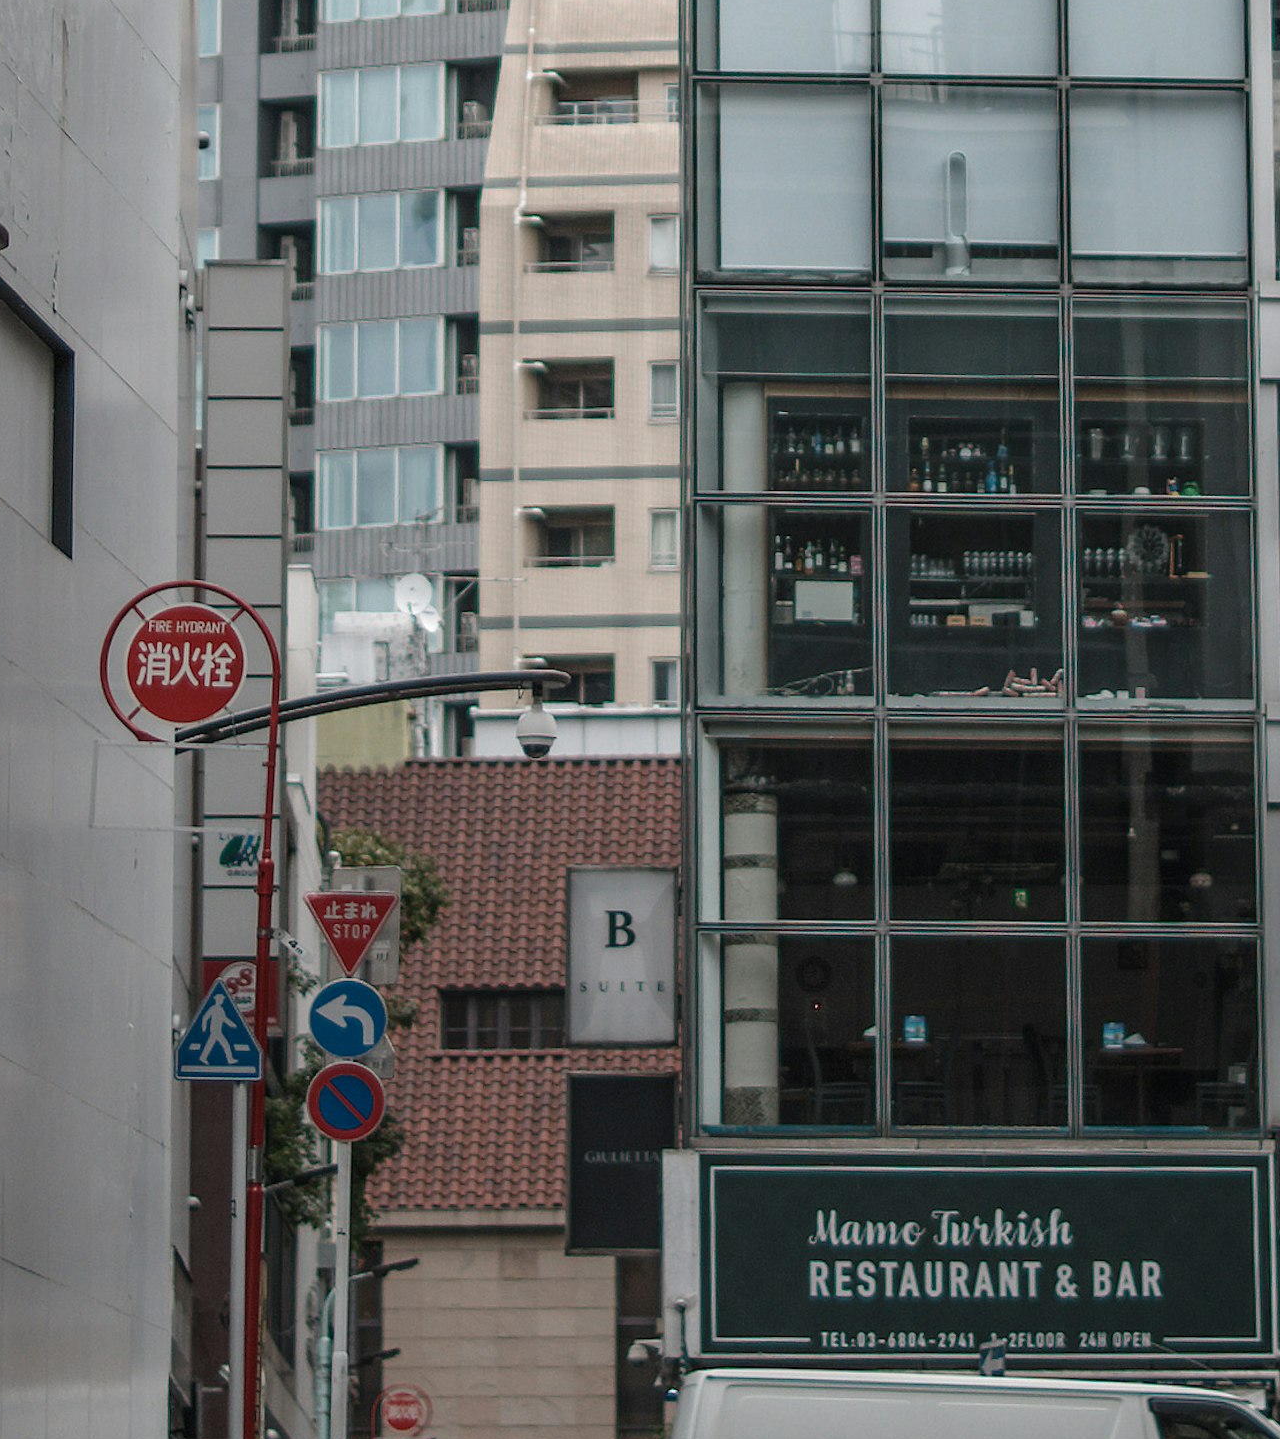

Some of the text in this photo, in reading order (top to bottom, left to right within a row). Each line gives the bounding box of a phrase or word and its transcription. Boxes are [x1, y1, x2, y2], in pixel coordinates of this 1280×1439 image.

[148, 619, 228, 634] FIRE HYDRANT
[136, 640, 237, 687] 消火栓
[323, 900, 379, 920] 止まれ
[332, 923, 372, 939] STOP
[604, 910, 637, 948] B
[579, 981, 666, 993] SUITE
[583, 1150, 661, 1164] GIULIETTA
[808, 1206, 1074, 1248] Mamo Turkish
[808, 1260, 1164, 1298] RESTAURANT & BAR
[1078, 1331, 1108, 1349] 24H
[1112, 1331, 1152, 1349] OPEN
